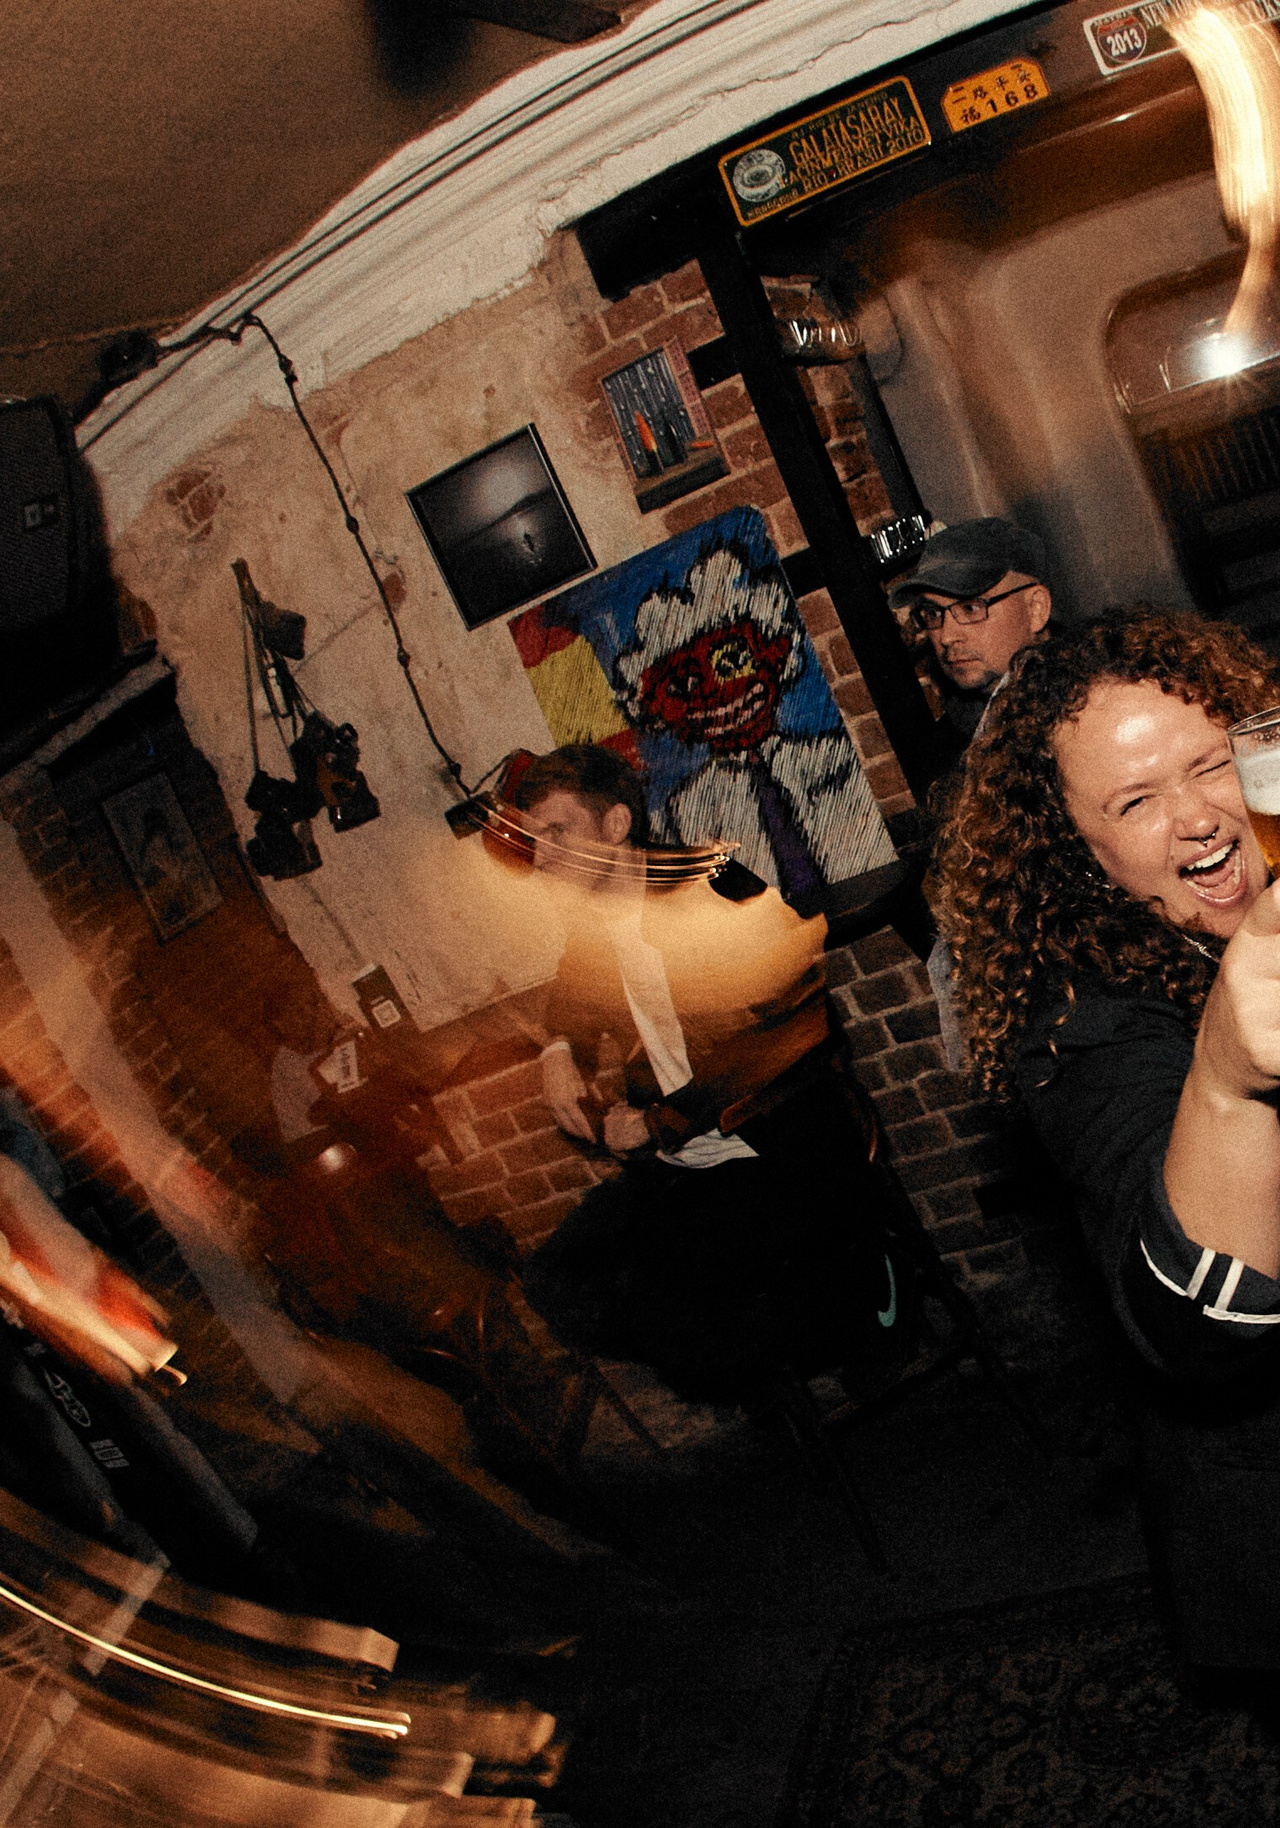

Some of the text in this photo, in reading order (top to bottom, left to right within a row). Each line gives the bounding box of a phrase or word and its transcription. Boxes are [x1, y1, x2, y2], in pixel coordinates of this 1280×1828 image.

[1140, 1, 1171, 29] NEW
[1107, 28, 1142, 57] 2013
[788, 97, 905, 167] GALATASARAY
[801, 171, 828, 193] RIO
[886, 128, 923, 155] 2010
